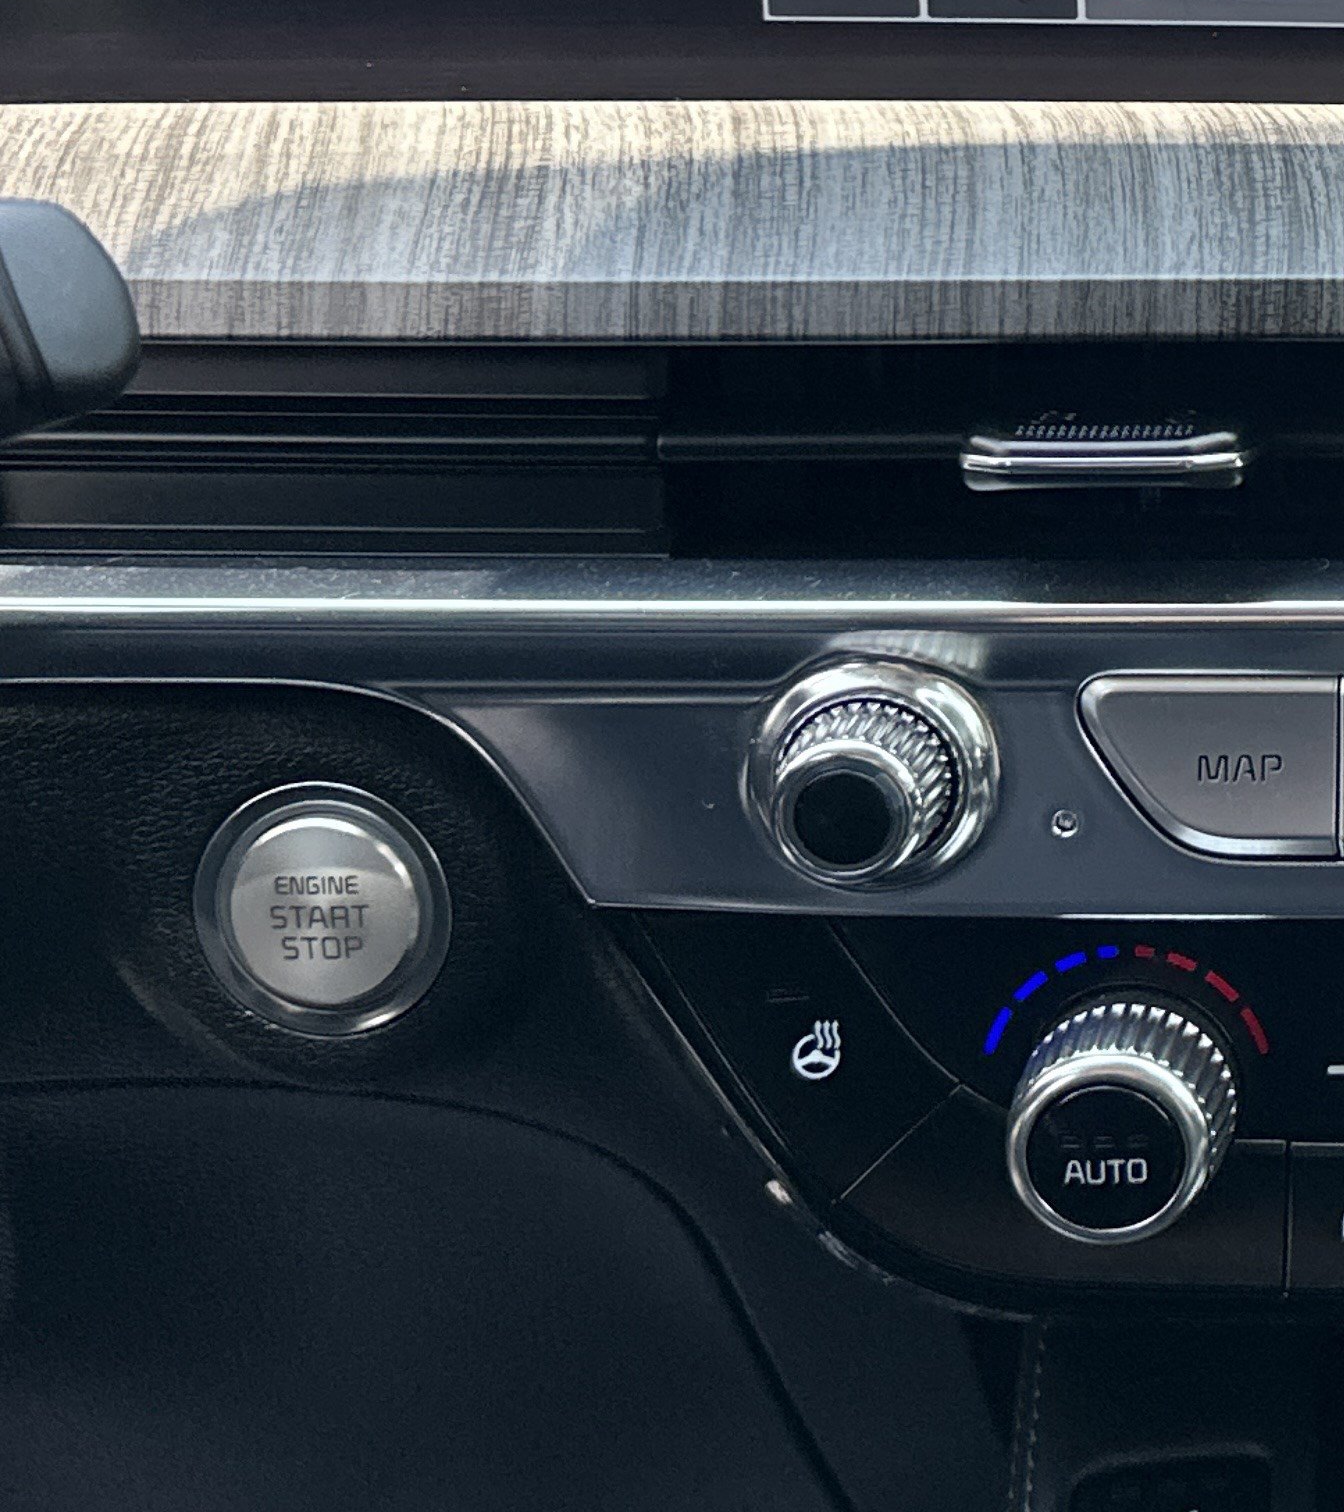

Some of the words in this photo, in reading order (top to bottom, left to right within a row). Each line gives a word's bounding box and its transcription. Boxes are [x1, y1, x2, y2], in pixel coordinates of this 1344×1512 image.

[1197, 755, 1284, 783] MAP
[274, 875, 359, 895] ENGINE
[270, 906, 369, 929] START
[281, 937, 364, 959] STOP
[1064, 1158, 1148, 1185] AUTO
